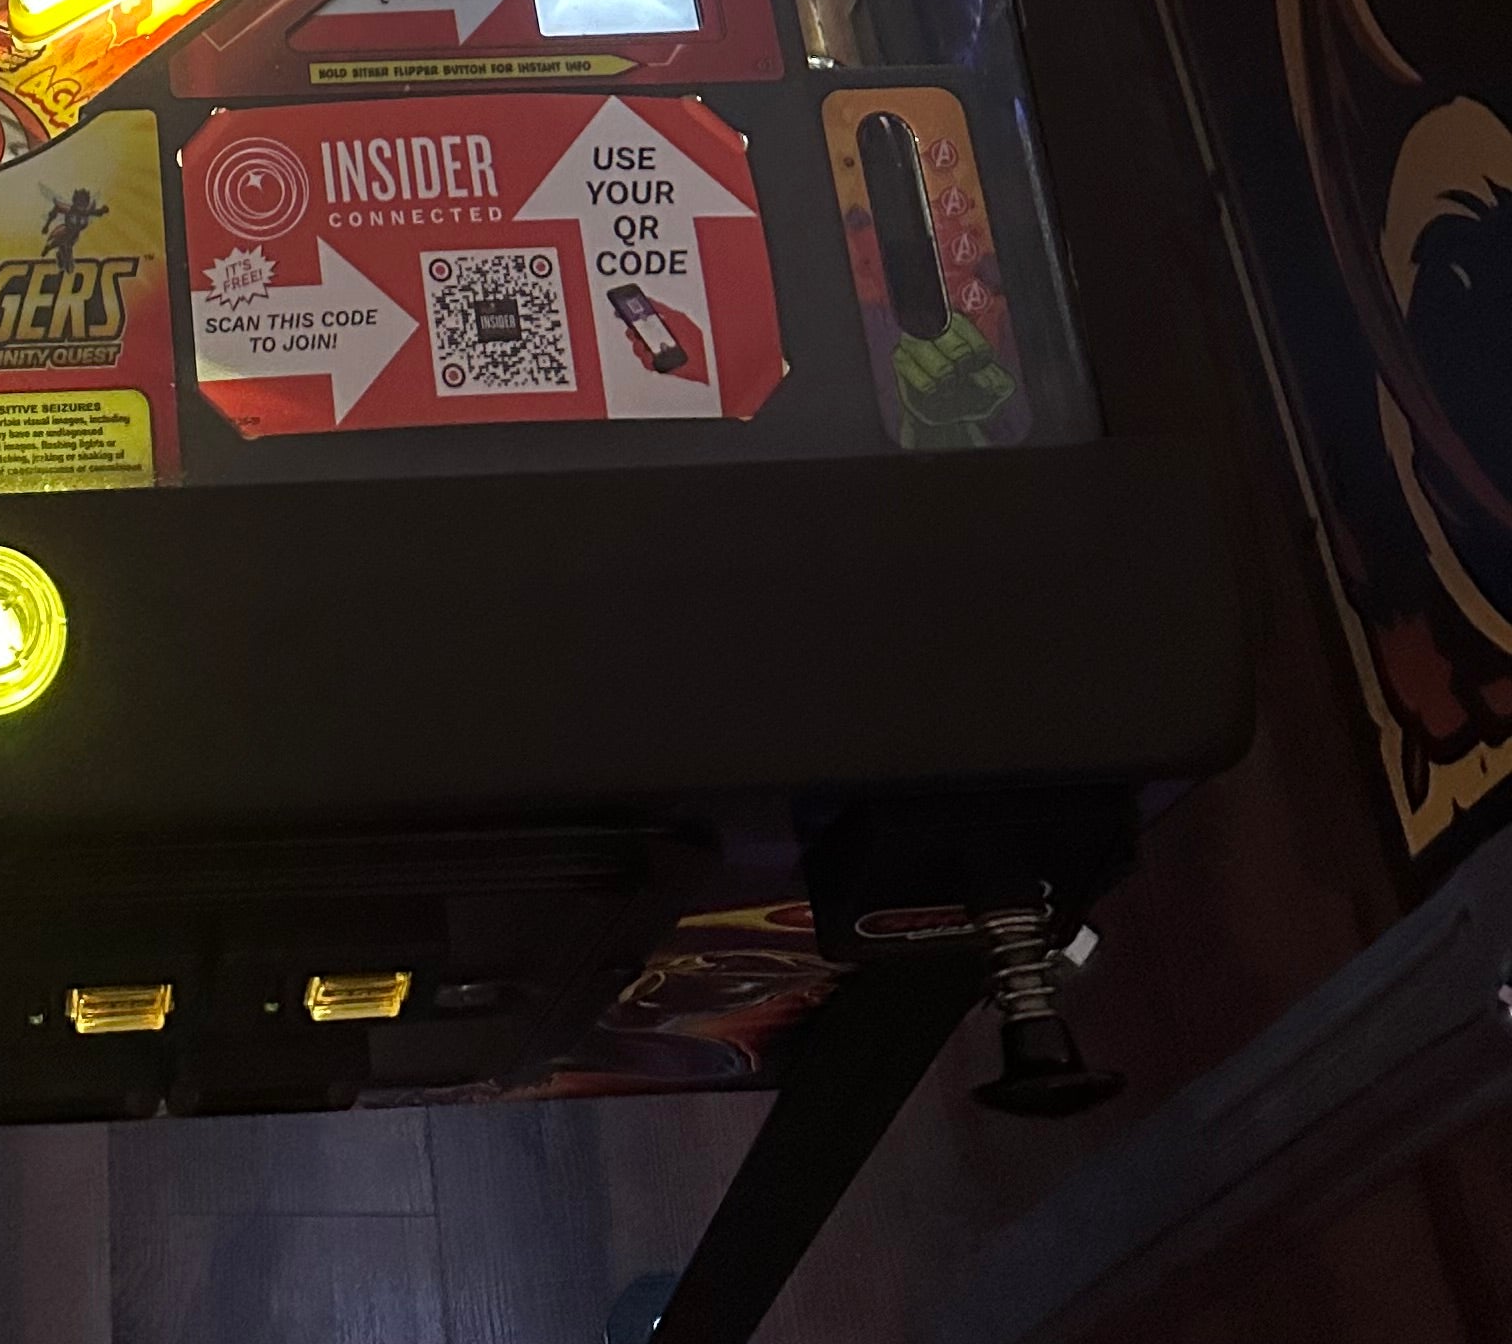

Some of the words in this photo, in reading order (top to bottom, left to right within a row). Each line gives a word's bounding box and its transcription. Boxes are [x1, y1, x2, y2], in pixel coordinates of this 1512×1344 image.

[319, 69, 347, 80] HOLD
[353, 68, 389, 78] EITHER
[394, 66, 438, 77] FLIPPER
[443, 65, 486, 75] BUTTON
[491, 63, 513, 74] FOR
[518, 62, 561, 73] INSTANT
[566, 61, 591, 72] INFO
[321, 134, 499, 204] INSIDER
[592, 147, 657, 170] USE
[587, 180, 675, 205] YOUR
[329, 206, 503, 227] CONNECTED
[614, 215, 660, 241] QR
[225, 258, 251, 278] IT'S
[595, 250, 689, 276] CODE
[222, 269, 264, 293] FREE!
[205, 315, 260, 334] SCAN
[268, 313, 315, 331] THIS
[320, 309, 379, 328] CODE
[480, 313, 516, 330] INSIDER
[249, 335, 277, 353] TO
[282, 333, 338, 351] JOIN!
[53, 346, 117, 364] QUEST
[41, 402, 102, 414] SEIZURES
